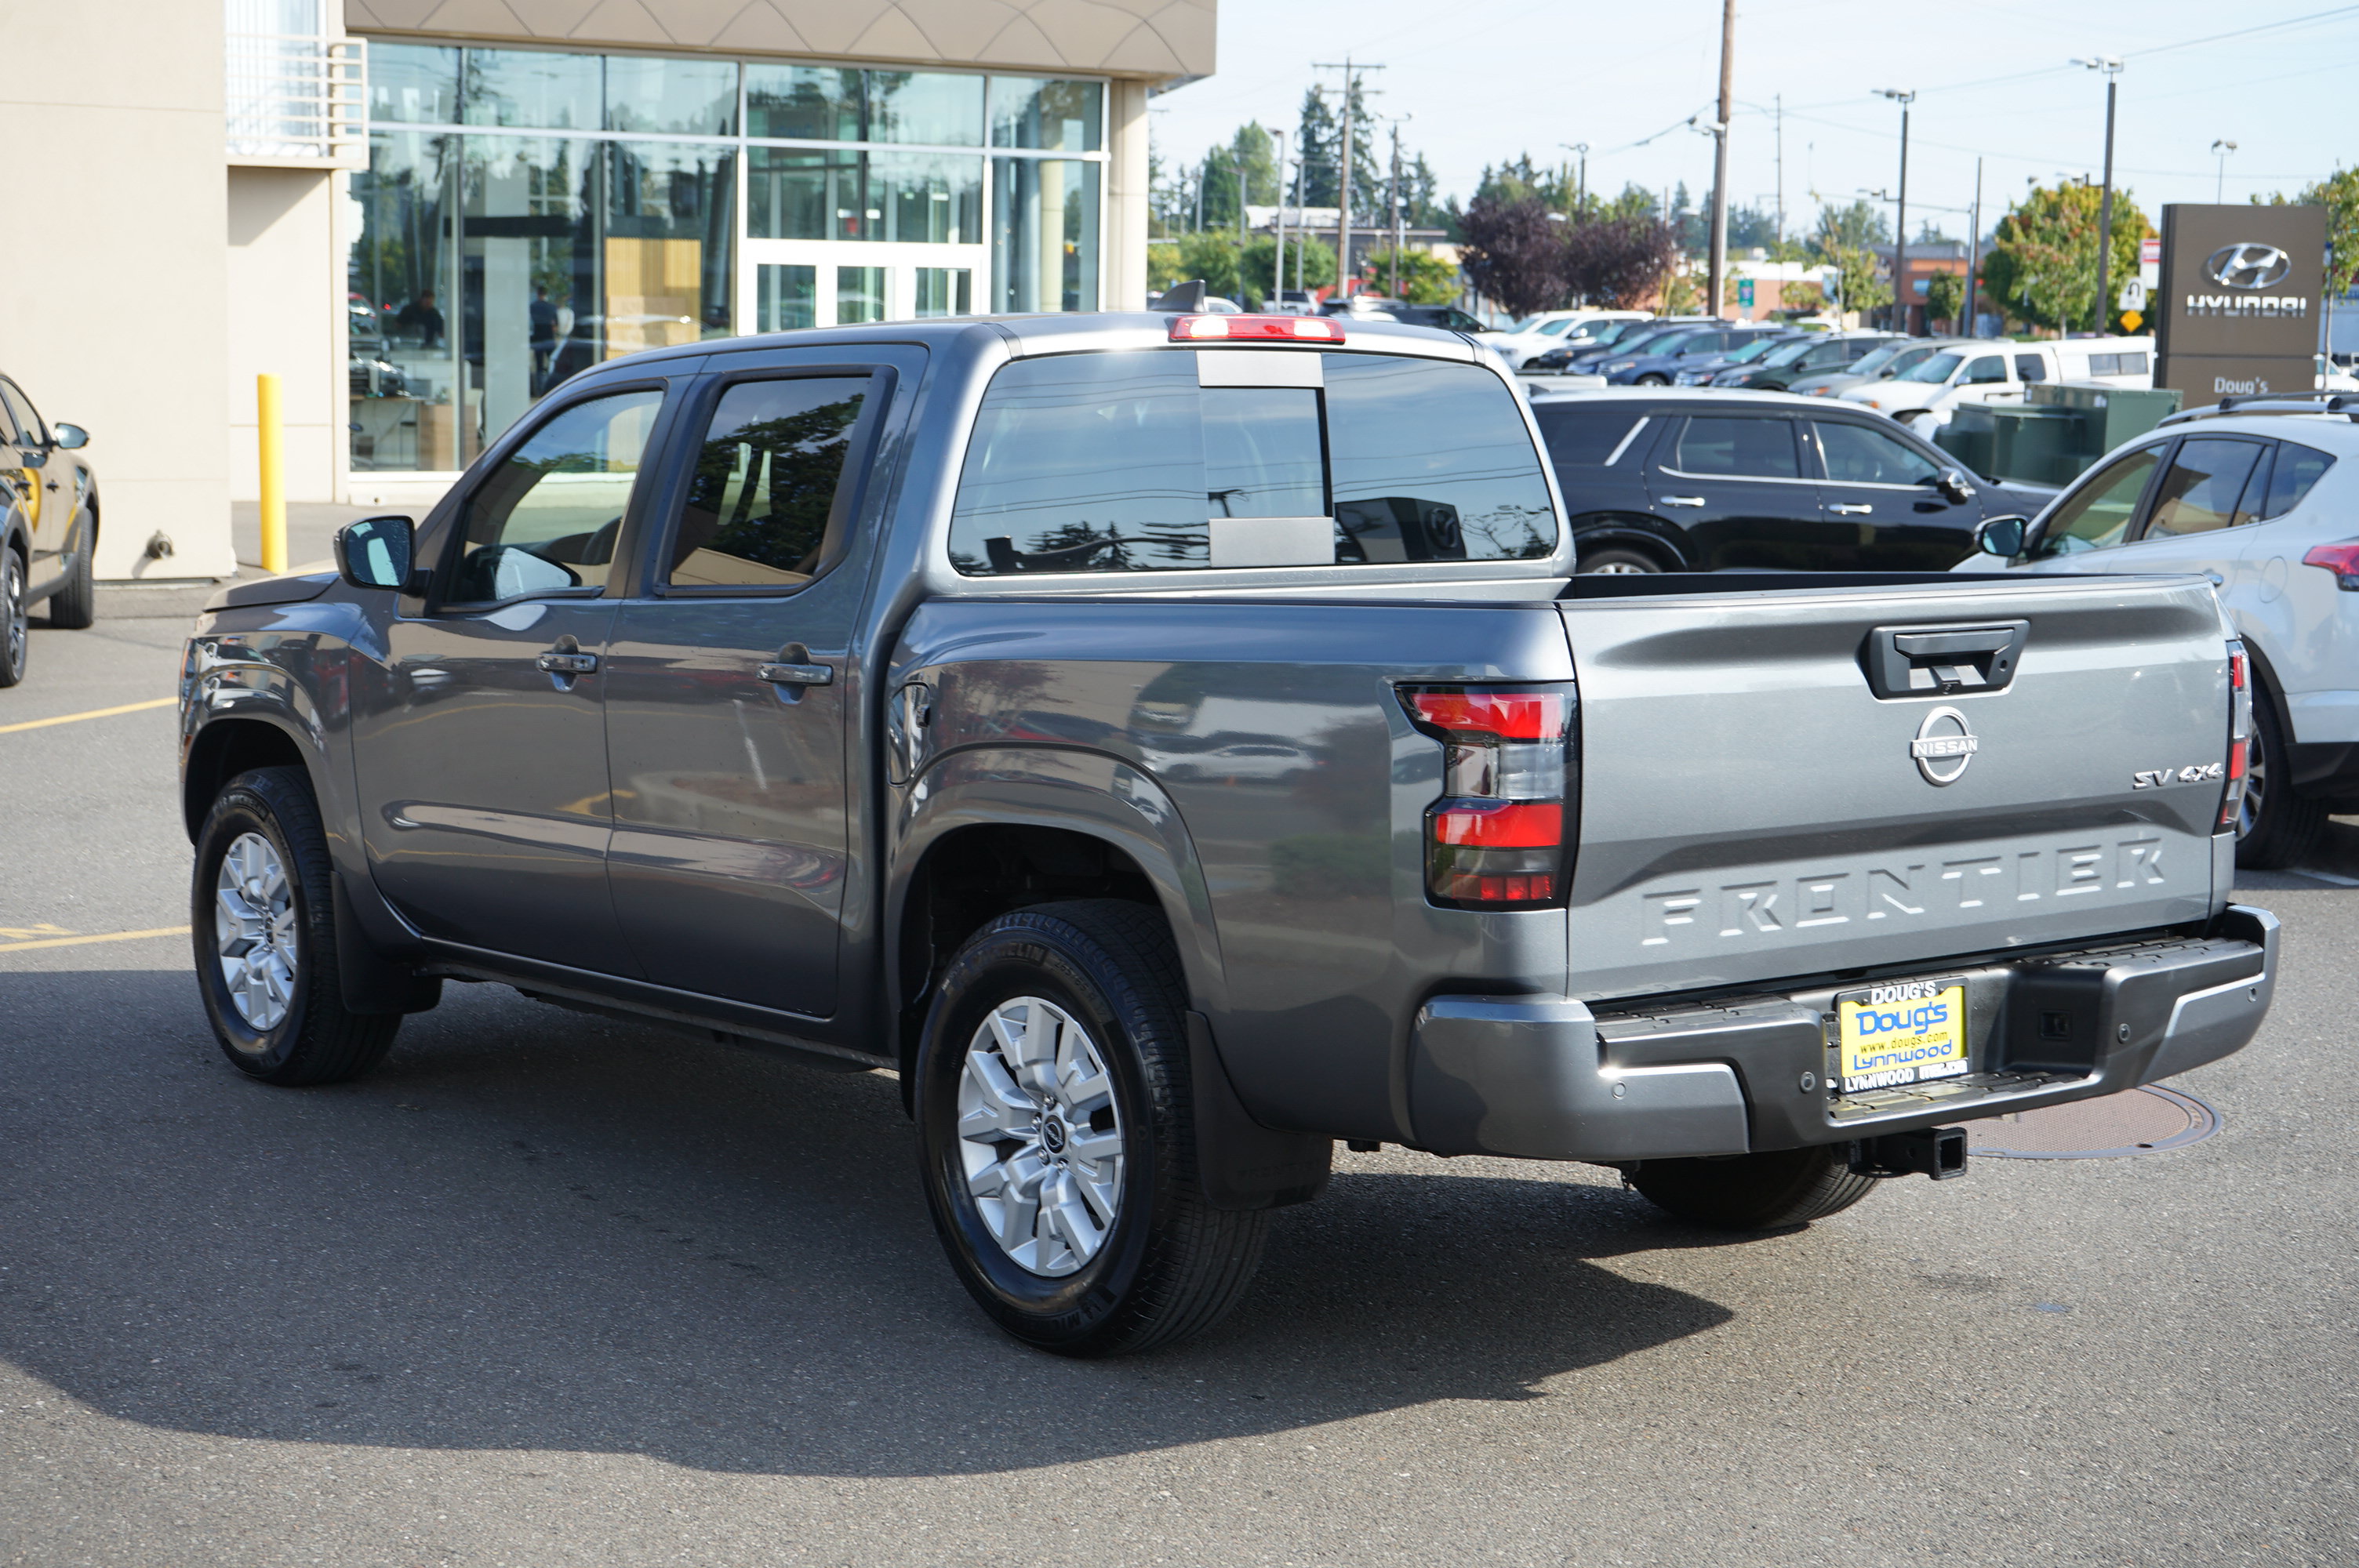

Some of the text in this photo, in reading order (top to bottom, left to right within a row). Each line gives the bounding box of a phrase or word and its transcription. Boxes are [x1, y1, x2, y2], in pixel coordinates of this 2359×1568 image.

[2186, 295, 2306, 318] HYUNDAI
[2214, 376, 2268, 394] Doug's
[1914, 739, 1978, 756] NISSAN
[2133, 768, 2174, 789] SV
[1643, 837, 2164, 945] FRONTIER
[1871, 981, 1936, 1005] DOUG'S
[1856, 1001, 1948, 1036] Doug's
[1859, 1031, 1949, 1054] www.dougs.com
[1853, 1039, 1952, 1070] Lynnwood
[1845, 1068, 1914, 1092] LYNNWOOD
